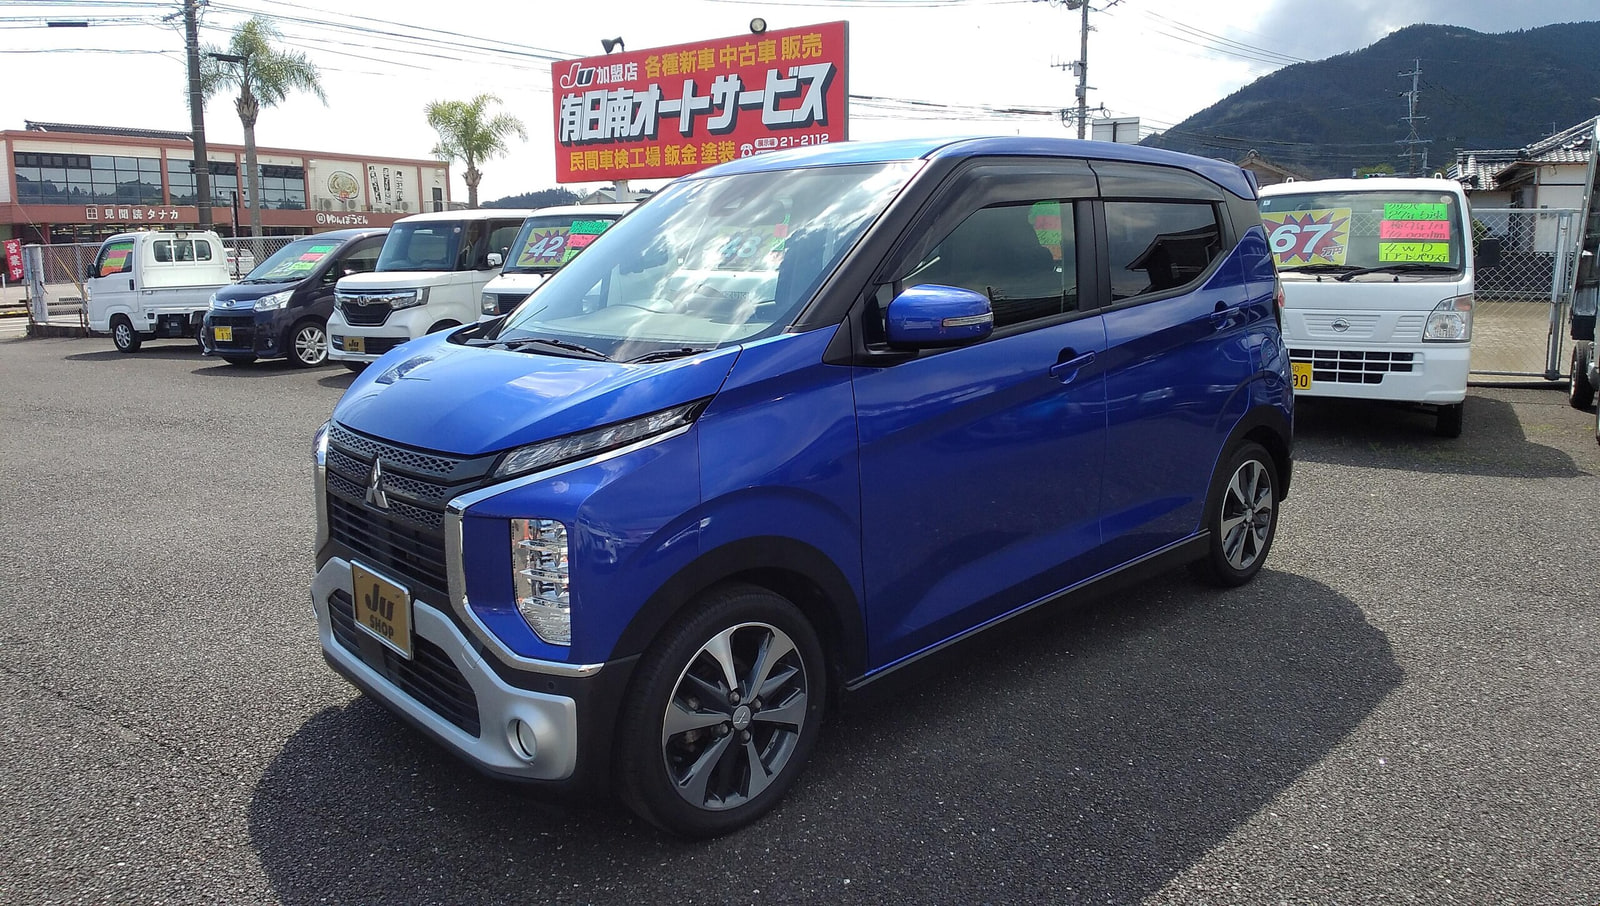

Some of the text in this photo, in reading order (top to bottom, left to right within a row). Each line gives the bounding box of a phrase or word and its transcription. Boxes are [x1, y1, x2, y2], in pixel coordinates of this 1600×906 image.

[645, 32, 822, 79] 各種新車 中古車 販売
[597, 62, 638, 84] 加盟店
[780, 133, 829, 147] 21-2112
[570, 140, 735, 171] 民間車検工場 鈑金 塗装
[528, 236, 564, 257] 42
[1269, 224, 1333, 253] 67
[6, 242, 22, 279] 営業中
[369, 614, 395, 639] SHOP
